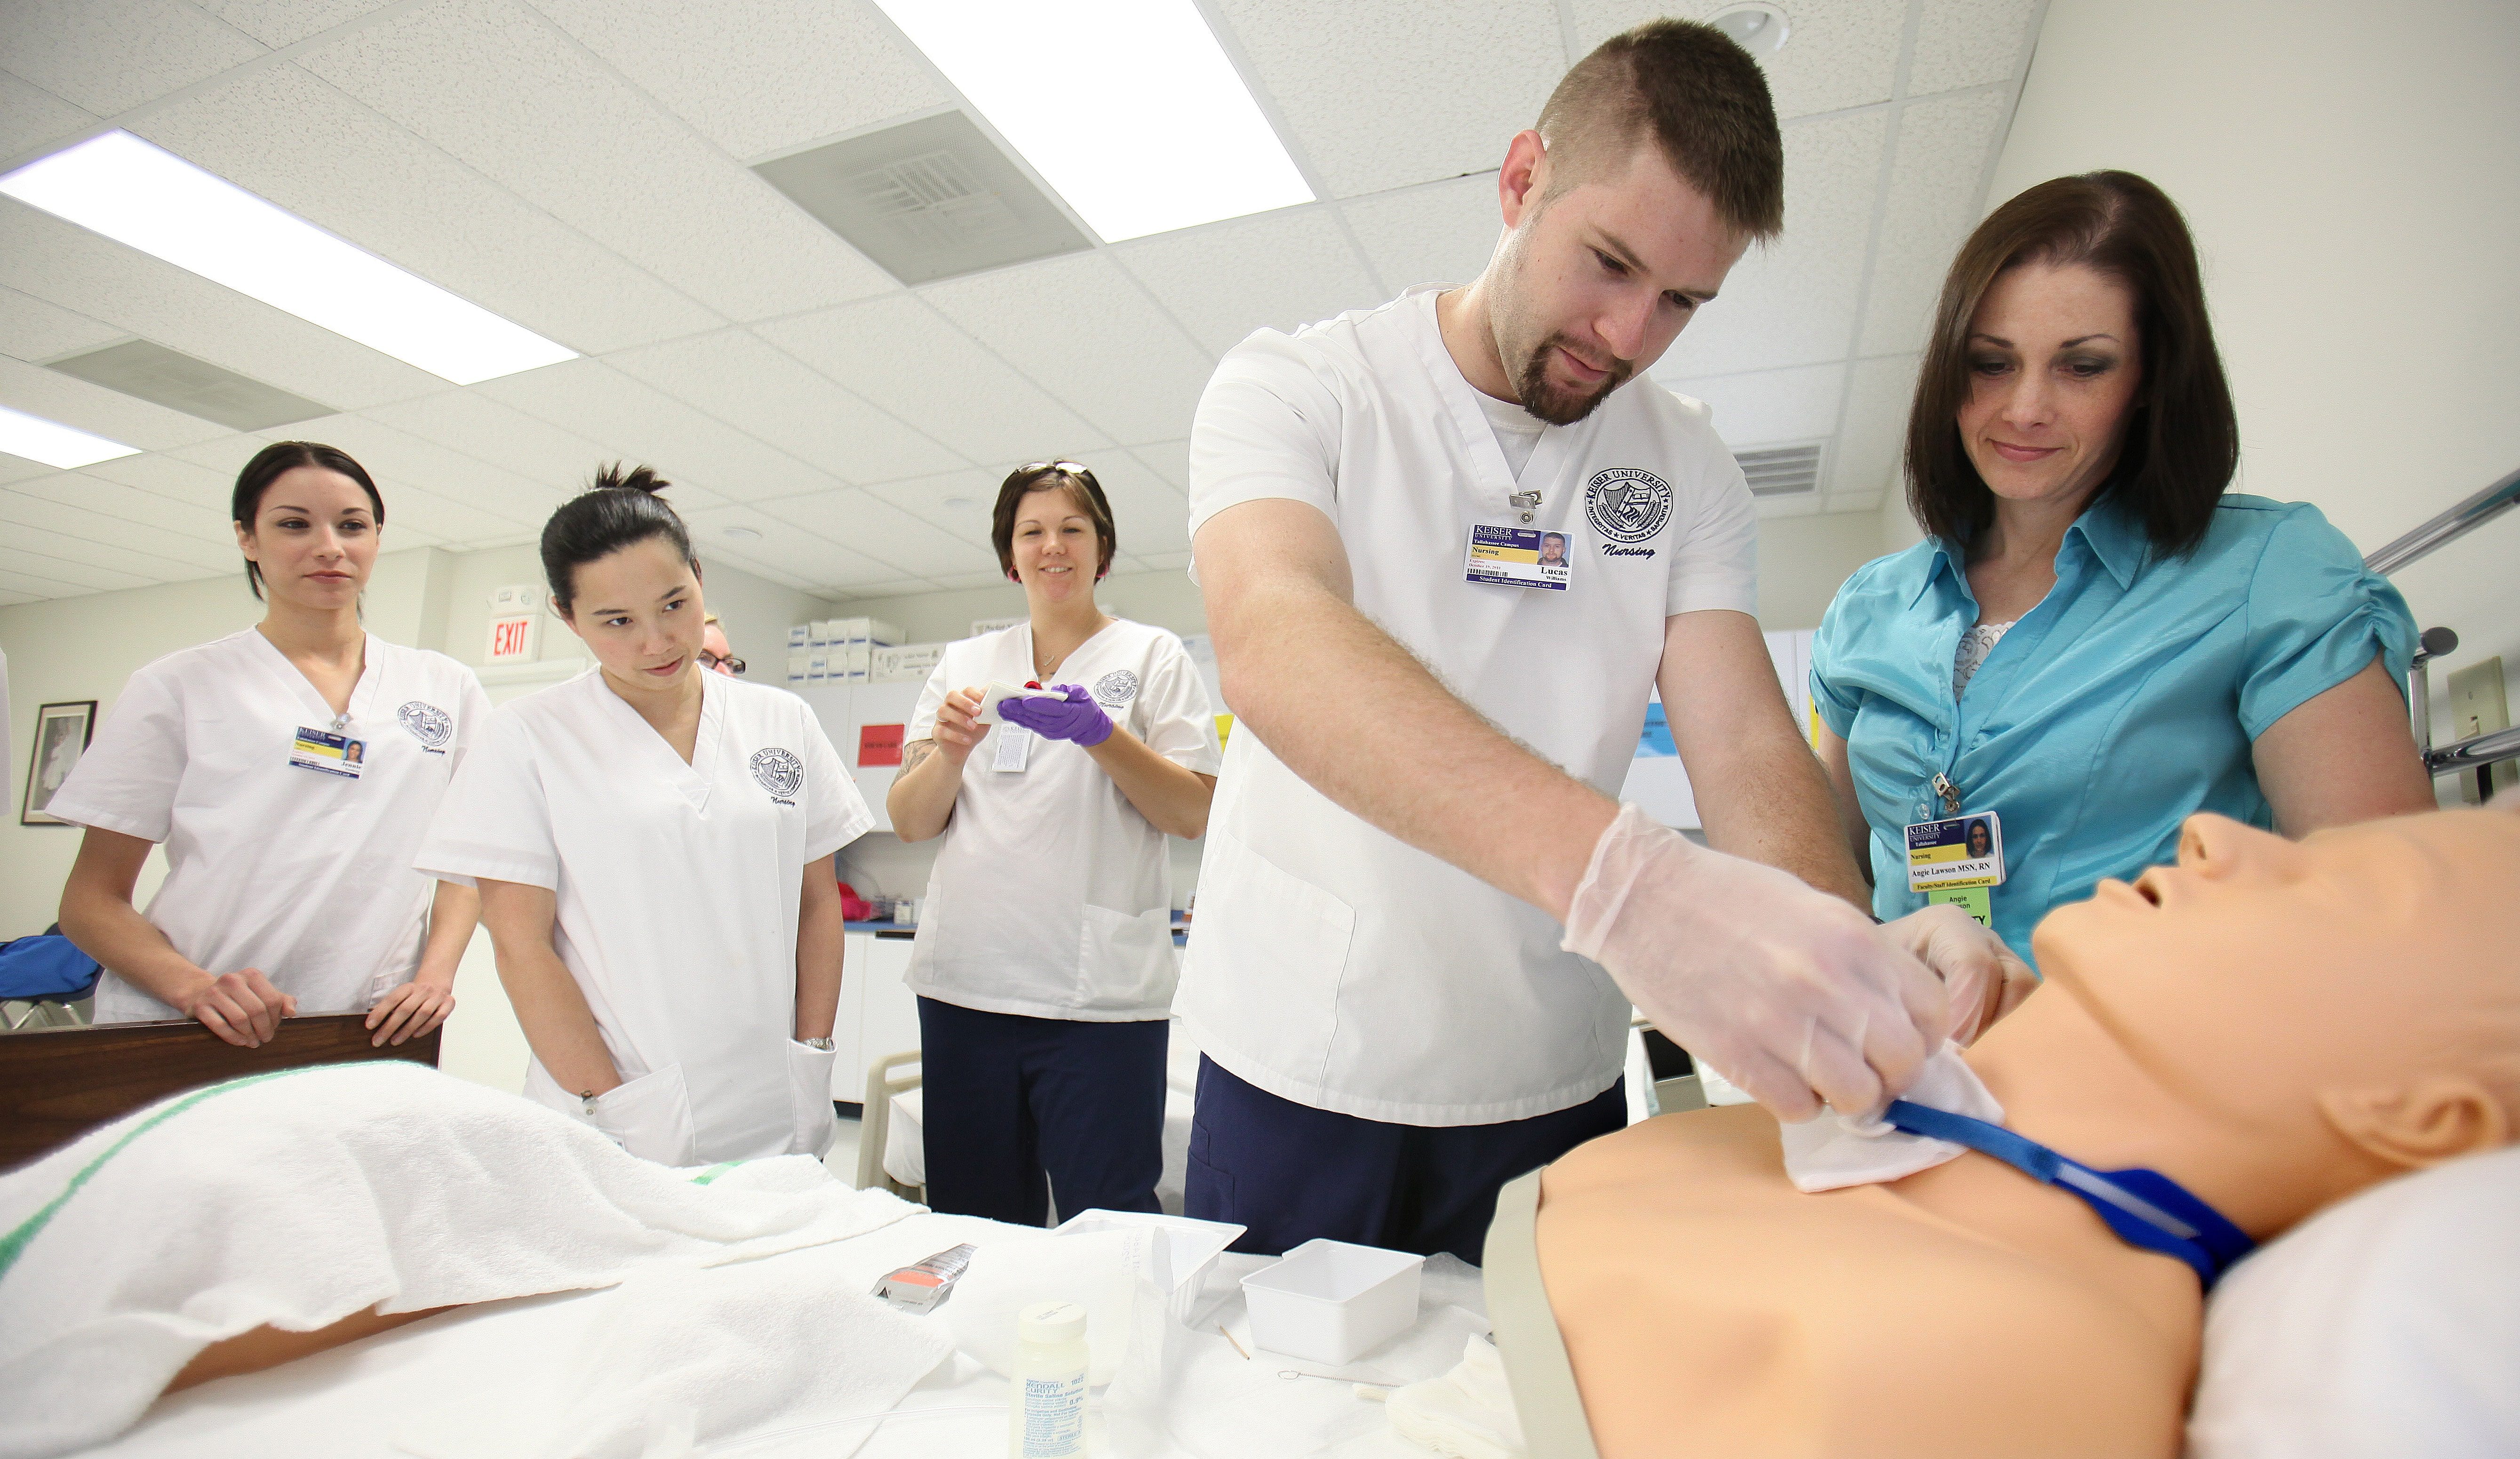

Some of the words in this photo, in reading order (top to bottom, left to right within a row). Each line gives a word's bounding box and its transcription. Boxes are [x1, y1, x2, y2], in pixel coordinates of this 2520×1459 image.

[1587, 473, 1612, 499] KEISER
[1612, 471, 1671, 498] UNIVERSITY
[1588, 506, 1612, 535] INTEGRITAS
[1620, 532, 1646, 540] VERITAS
[1476, 526, 1512, 536] KEISER
[1472, 547, 1499, 555] Nursing
[1602, 544, 1656, 560] Nursing
[1541, 567, 1568, 576] Lucas
[1501, 578, 1536, 587] Identification
[494, 621, 527, 656] EXIT
[763, 749, 801, 770] UNIVERSITY
[1909, 824, 1940, 835] KEISER
[1910, 833, 1940, 842] UNIVERSITY
[1912, 869, 1930, 878] Angie
[1071, 1377, 1084, 1386] 1022
